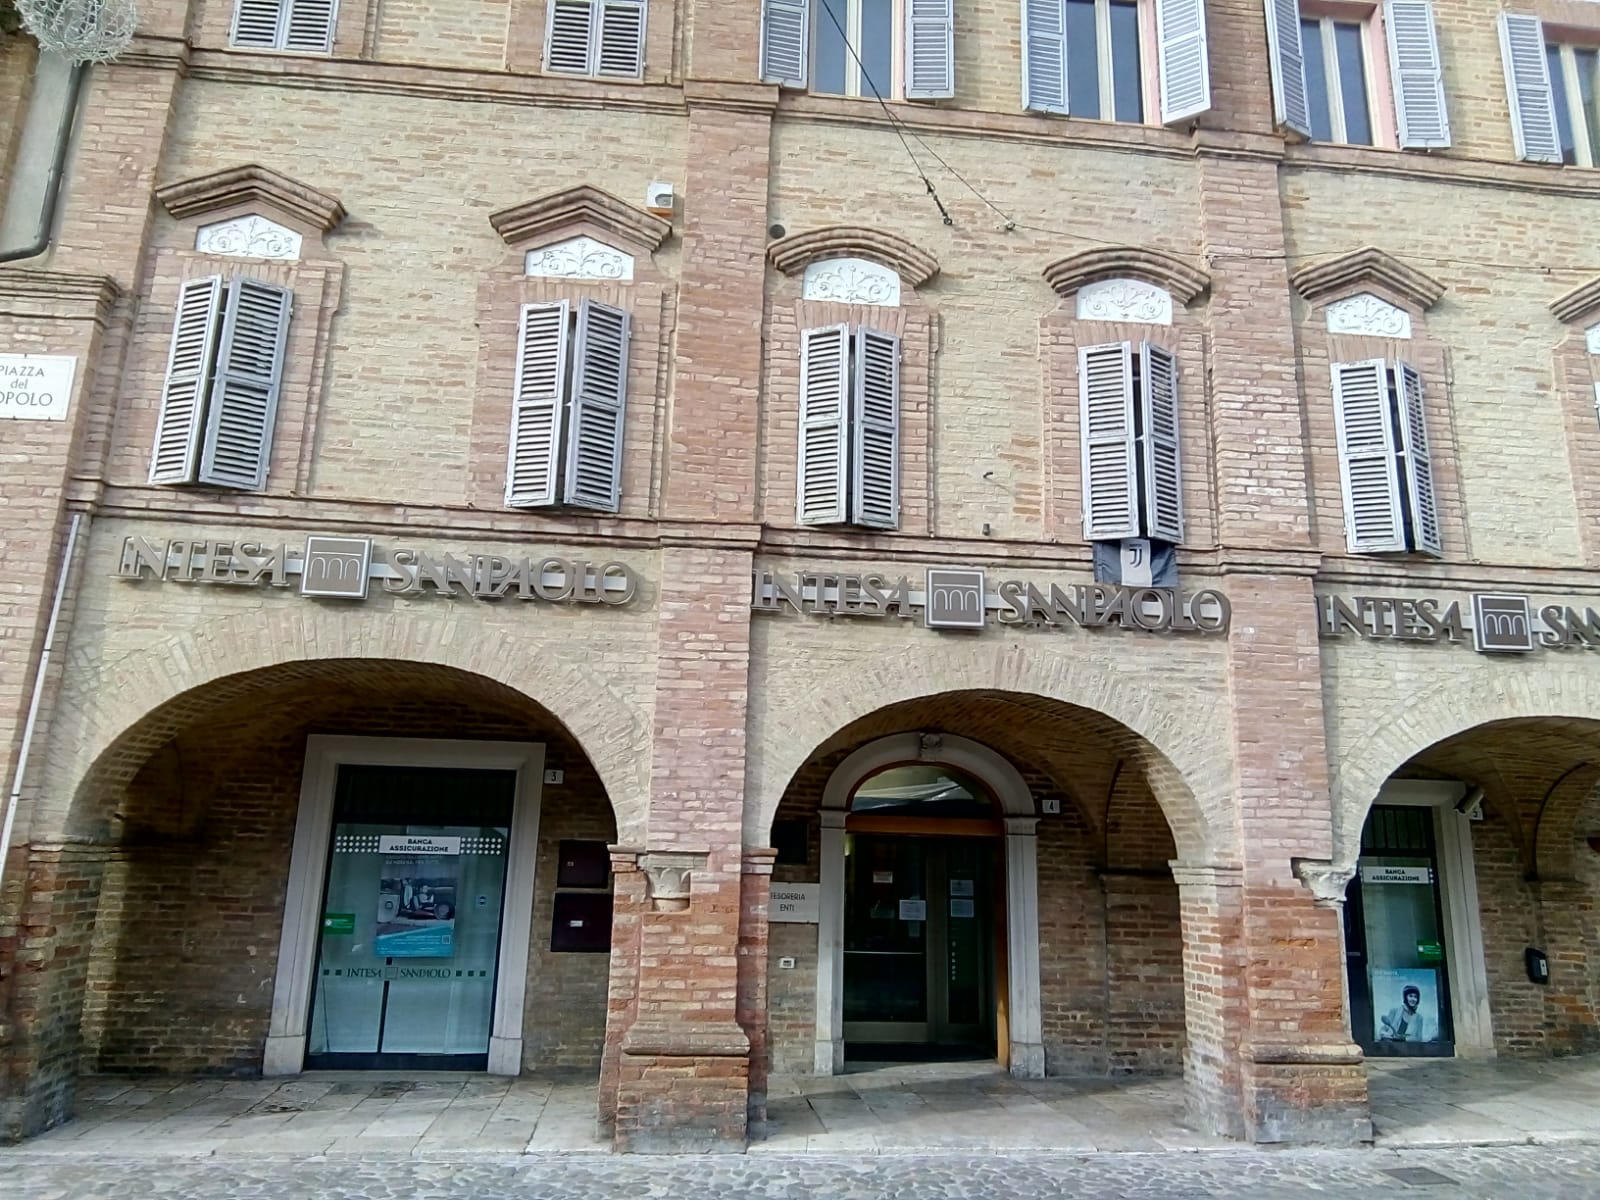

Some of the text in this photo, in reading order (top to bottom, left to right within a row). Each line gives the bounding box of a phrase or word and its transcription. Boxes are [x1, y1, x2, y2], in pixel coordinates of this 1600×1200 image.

[10, 378, 28, 389] del
[116, 535, 637, 605] INTESA SANPAOLO
[750, 567, 1232, 631] INTESA SANPAOLO
[1317, 594, 1466, 643] INTESA
[347, 968, 450, 978] INTESA SANPAOLO
